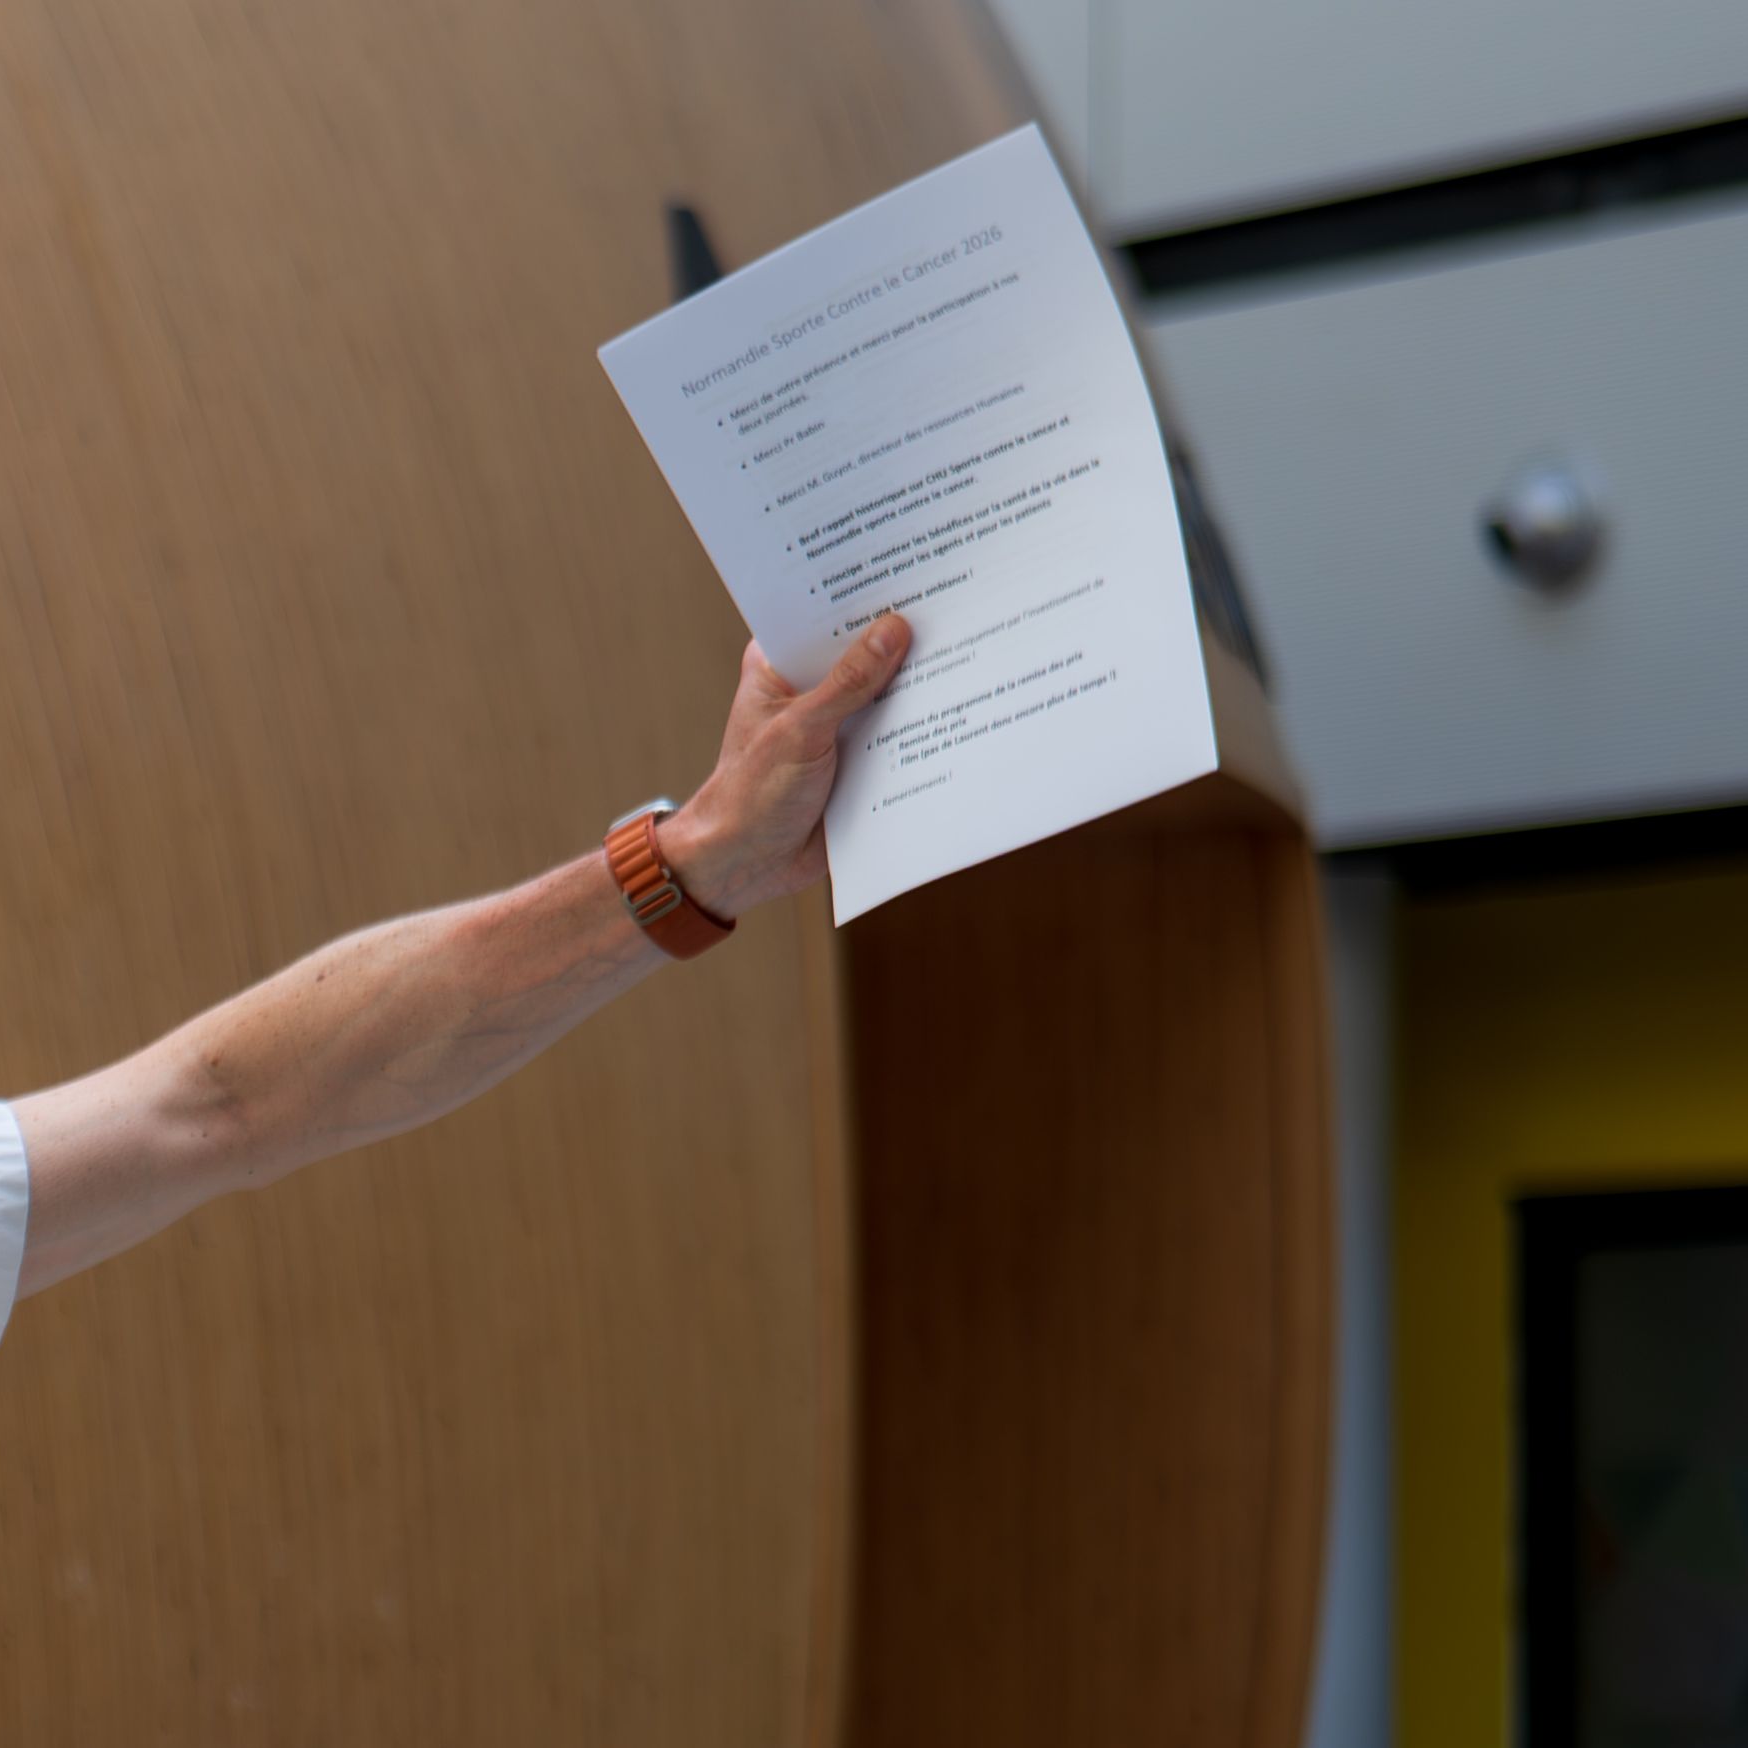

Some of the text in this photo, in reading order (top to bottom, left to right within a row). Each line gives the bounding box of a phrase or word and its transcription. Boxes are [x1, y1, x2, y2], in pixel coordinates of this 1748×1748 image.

[681, 225, 1002, 397] Normandie Sporte Contre le Cancer 2026
[806, 526, 862, 560] Normandie
[864, 510, 897, 531] sporte
[898, 495, 930, 515] contre
[943, 475, 978, 496] cancer.
